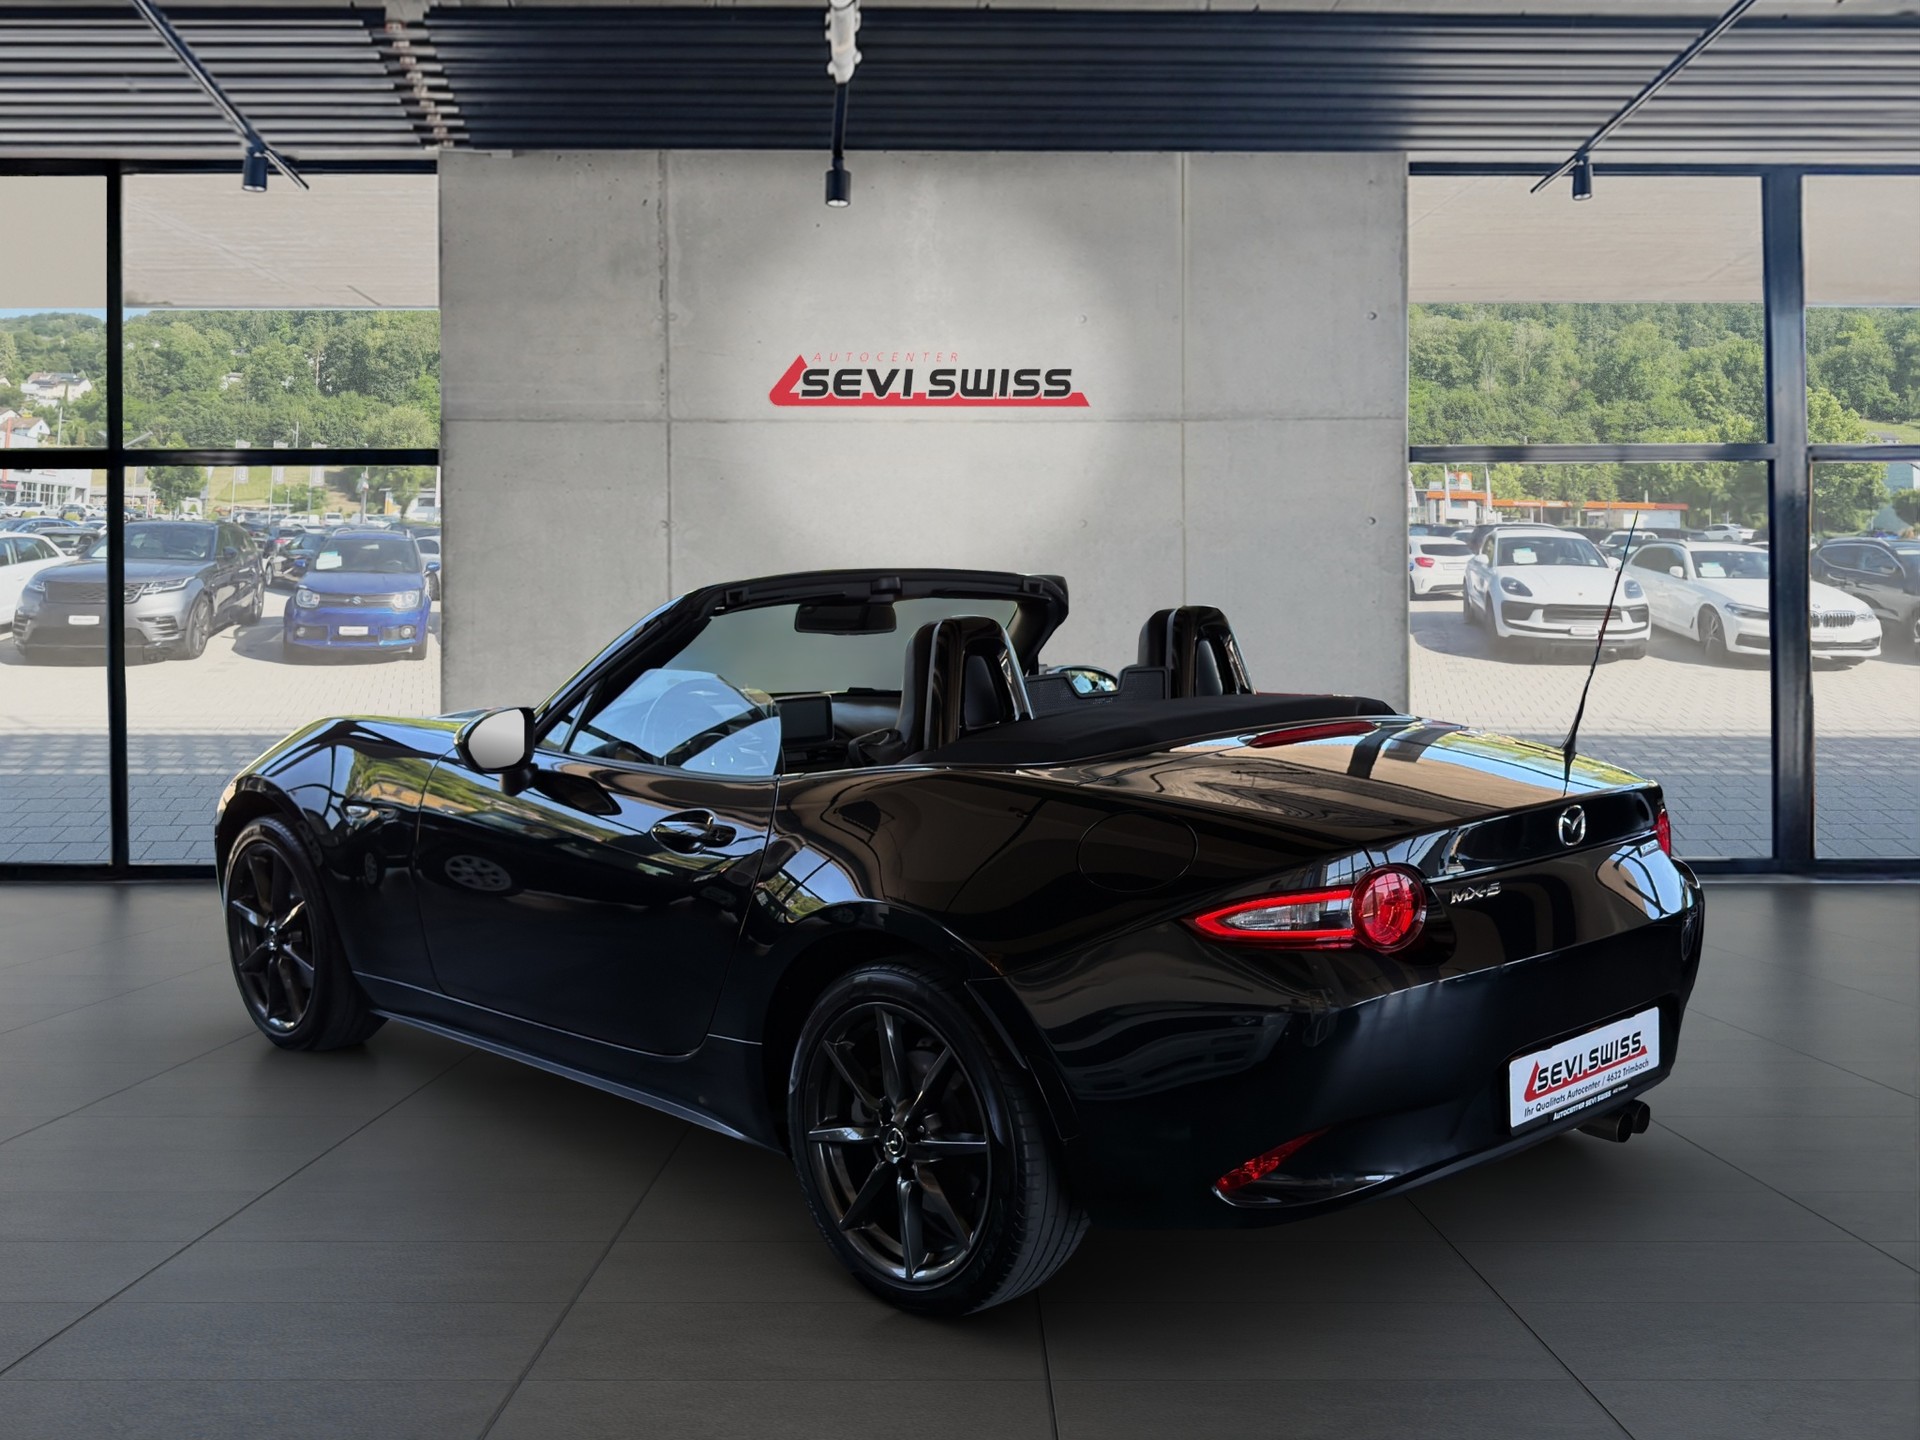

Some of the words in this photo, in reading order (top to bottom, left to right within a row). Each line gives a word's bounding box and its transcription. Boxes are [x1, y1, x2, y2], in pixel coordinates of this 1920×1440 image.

[812, 351, 960, 363] AUTOCENTER
[800, 368, 914, 398] SEVI
[927, 368, 1073, 398] SWISS
[1450, 881, 1502, 905] MX-5
[1537, 1053, 1583, 1092] SEVI
[1588, 1030, 1642, 1070] SWISS
[1524, 1106, 1534, 1118] Ihr
[1567, 1080, 1602, 1101] Autocenter
[1606, 1069, 1622, 1083] 4632
[1622, 1058, 1650, 1077] Trimbach
